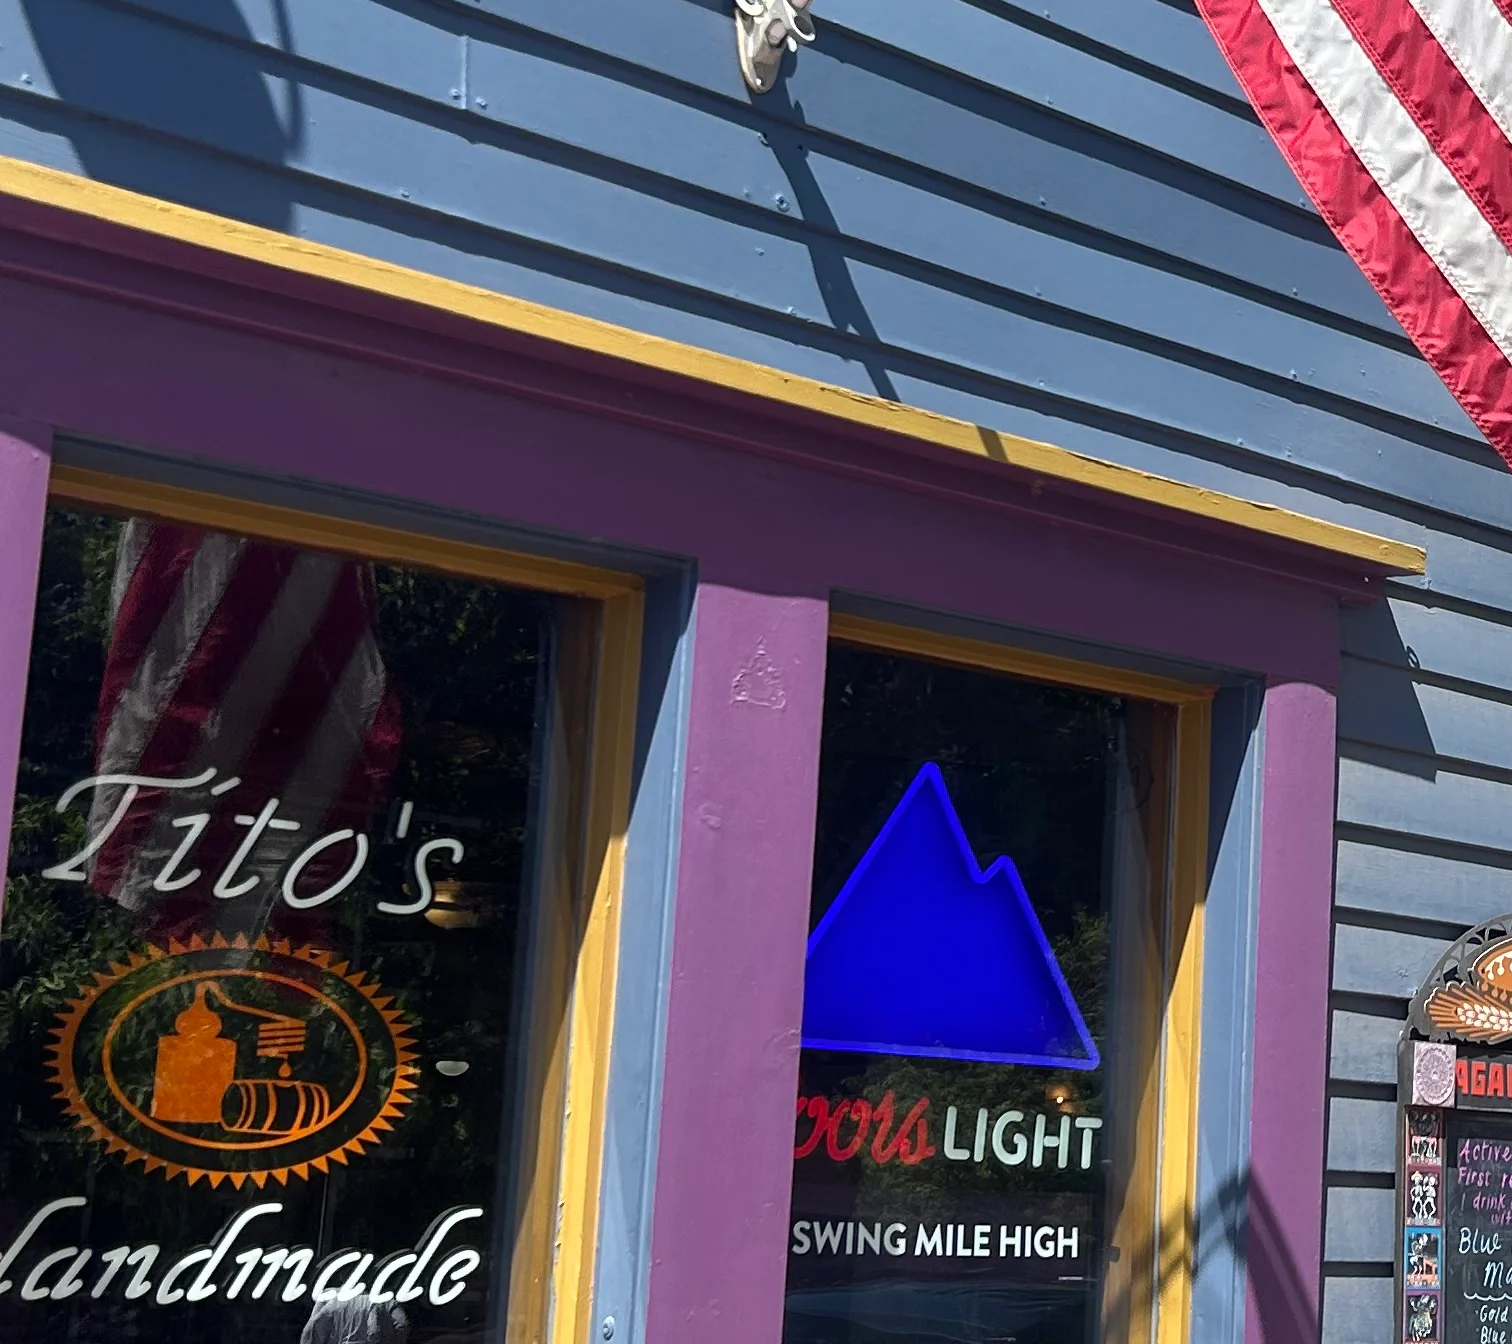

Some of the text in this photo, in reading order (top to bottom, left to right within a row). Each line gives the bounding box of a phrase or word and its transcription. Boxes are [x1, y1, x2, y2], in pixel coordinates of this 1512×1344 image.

[42, 767, 464, 914] Tito's
[794, 1089, 1103, 1170] oors LIGHT
[1460, 1139, 1512, 1164] Active
[1457, 1167, 1490, 1186] First
[1473, 1193, 1507, 1210] drink
[792, 1220, 1079, 1258] SWING MILE HIGH
[1459, 1227, 1501, 1254] Blue
[1479, 1305, 1508, 1324] Gold
[1480, 1326, 1506, 1344] Blue
